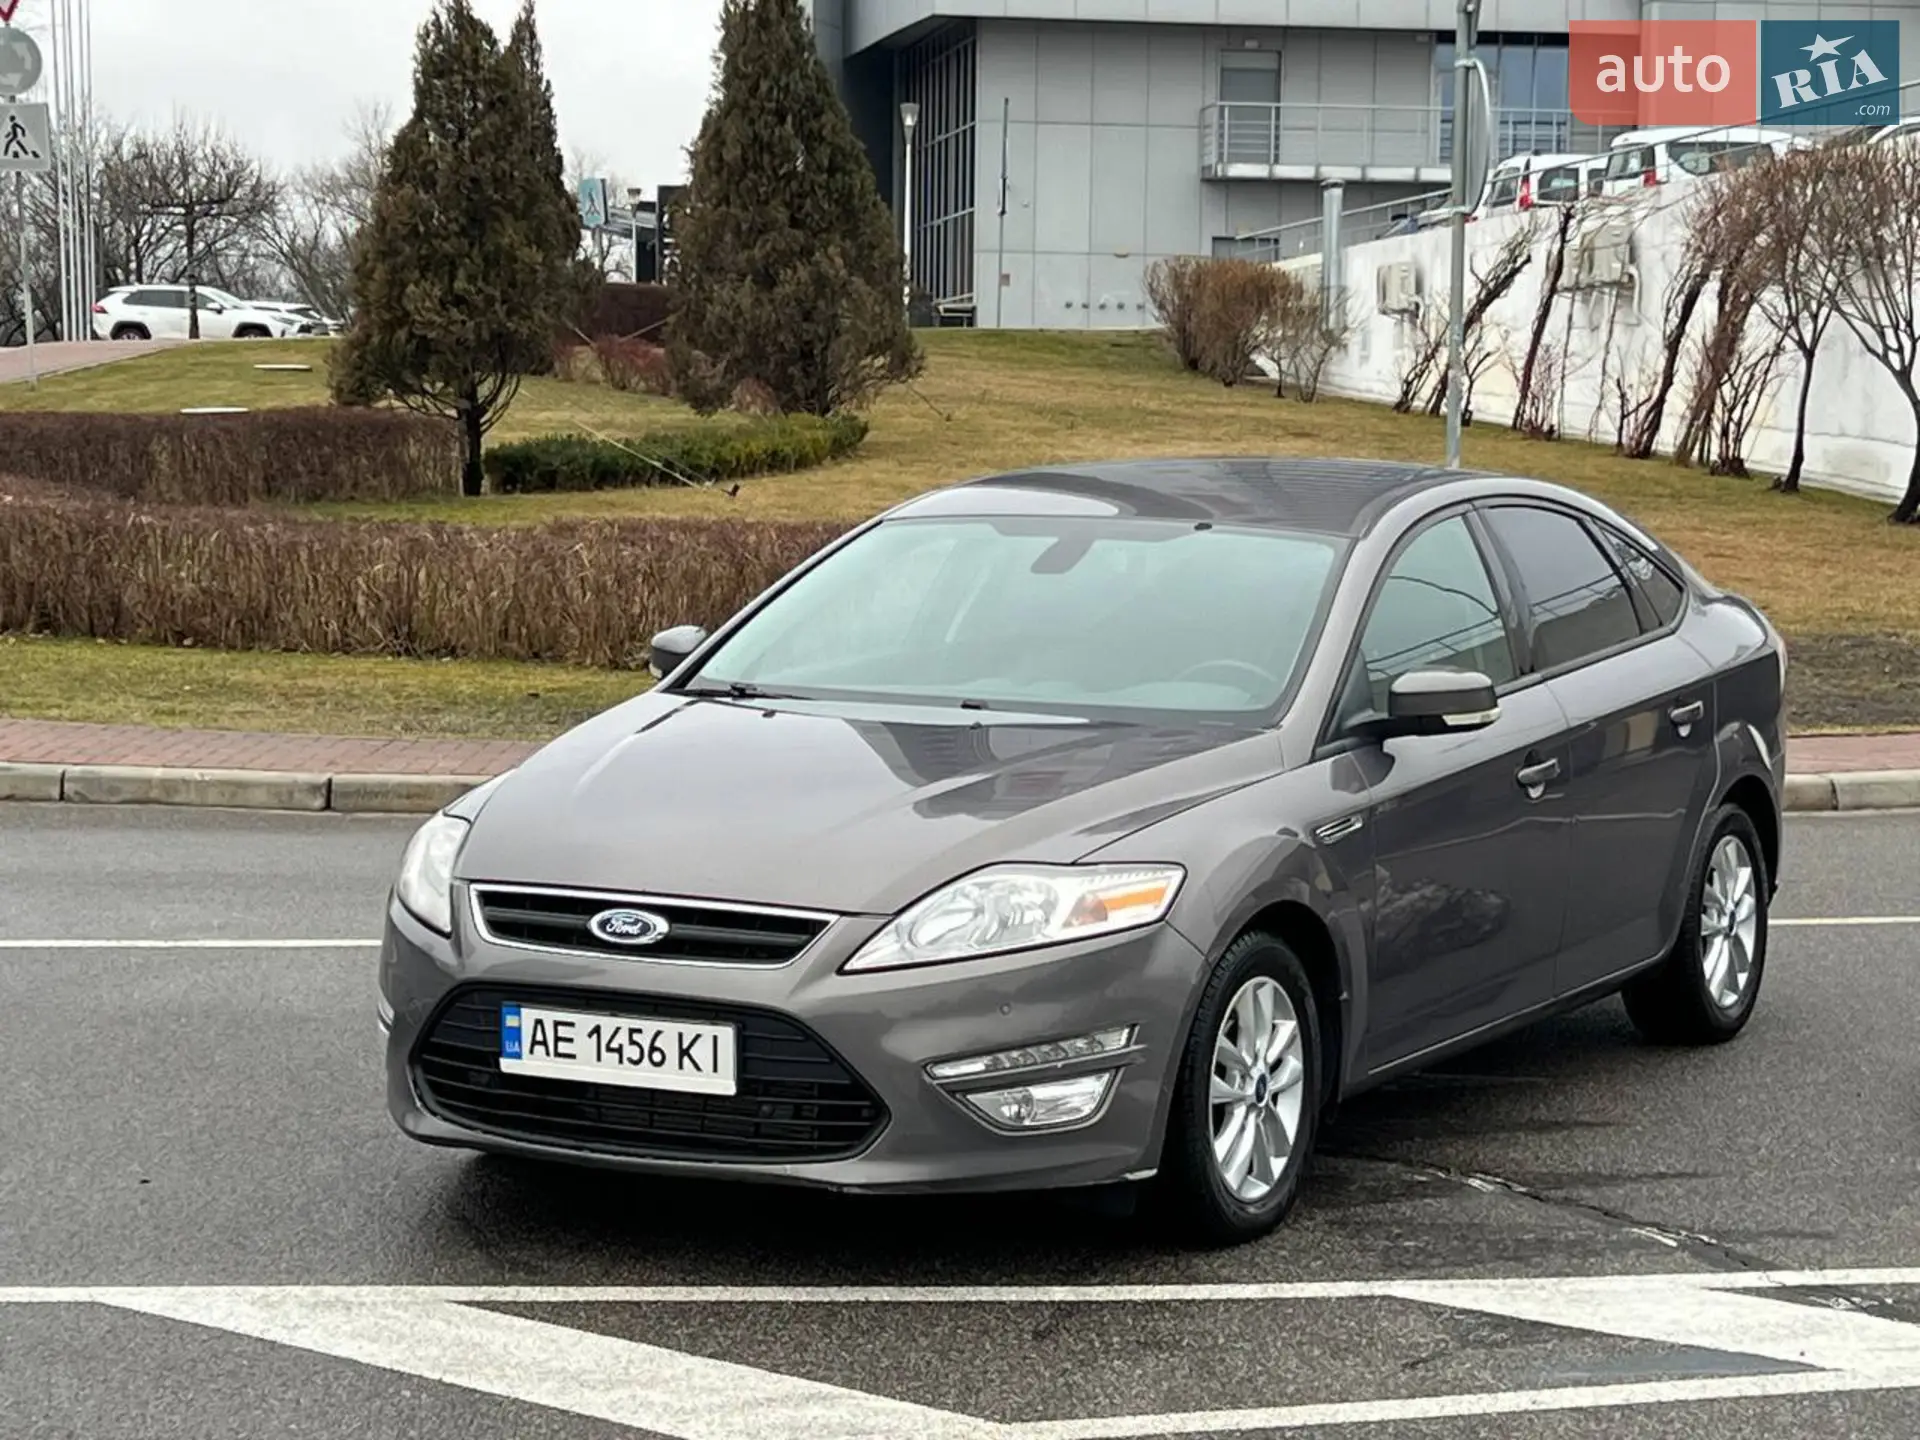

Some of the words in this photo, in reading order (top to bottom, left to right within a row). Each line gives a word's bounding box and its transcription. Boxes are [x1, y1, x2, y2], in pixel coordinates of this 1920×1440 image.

[605, 914, 643, 935] Ford
[528, 1018, 577, 1060] AE
[586, 1023, 667, 1068] 1456
[677, 1031, 718, 1074] KI
